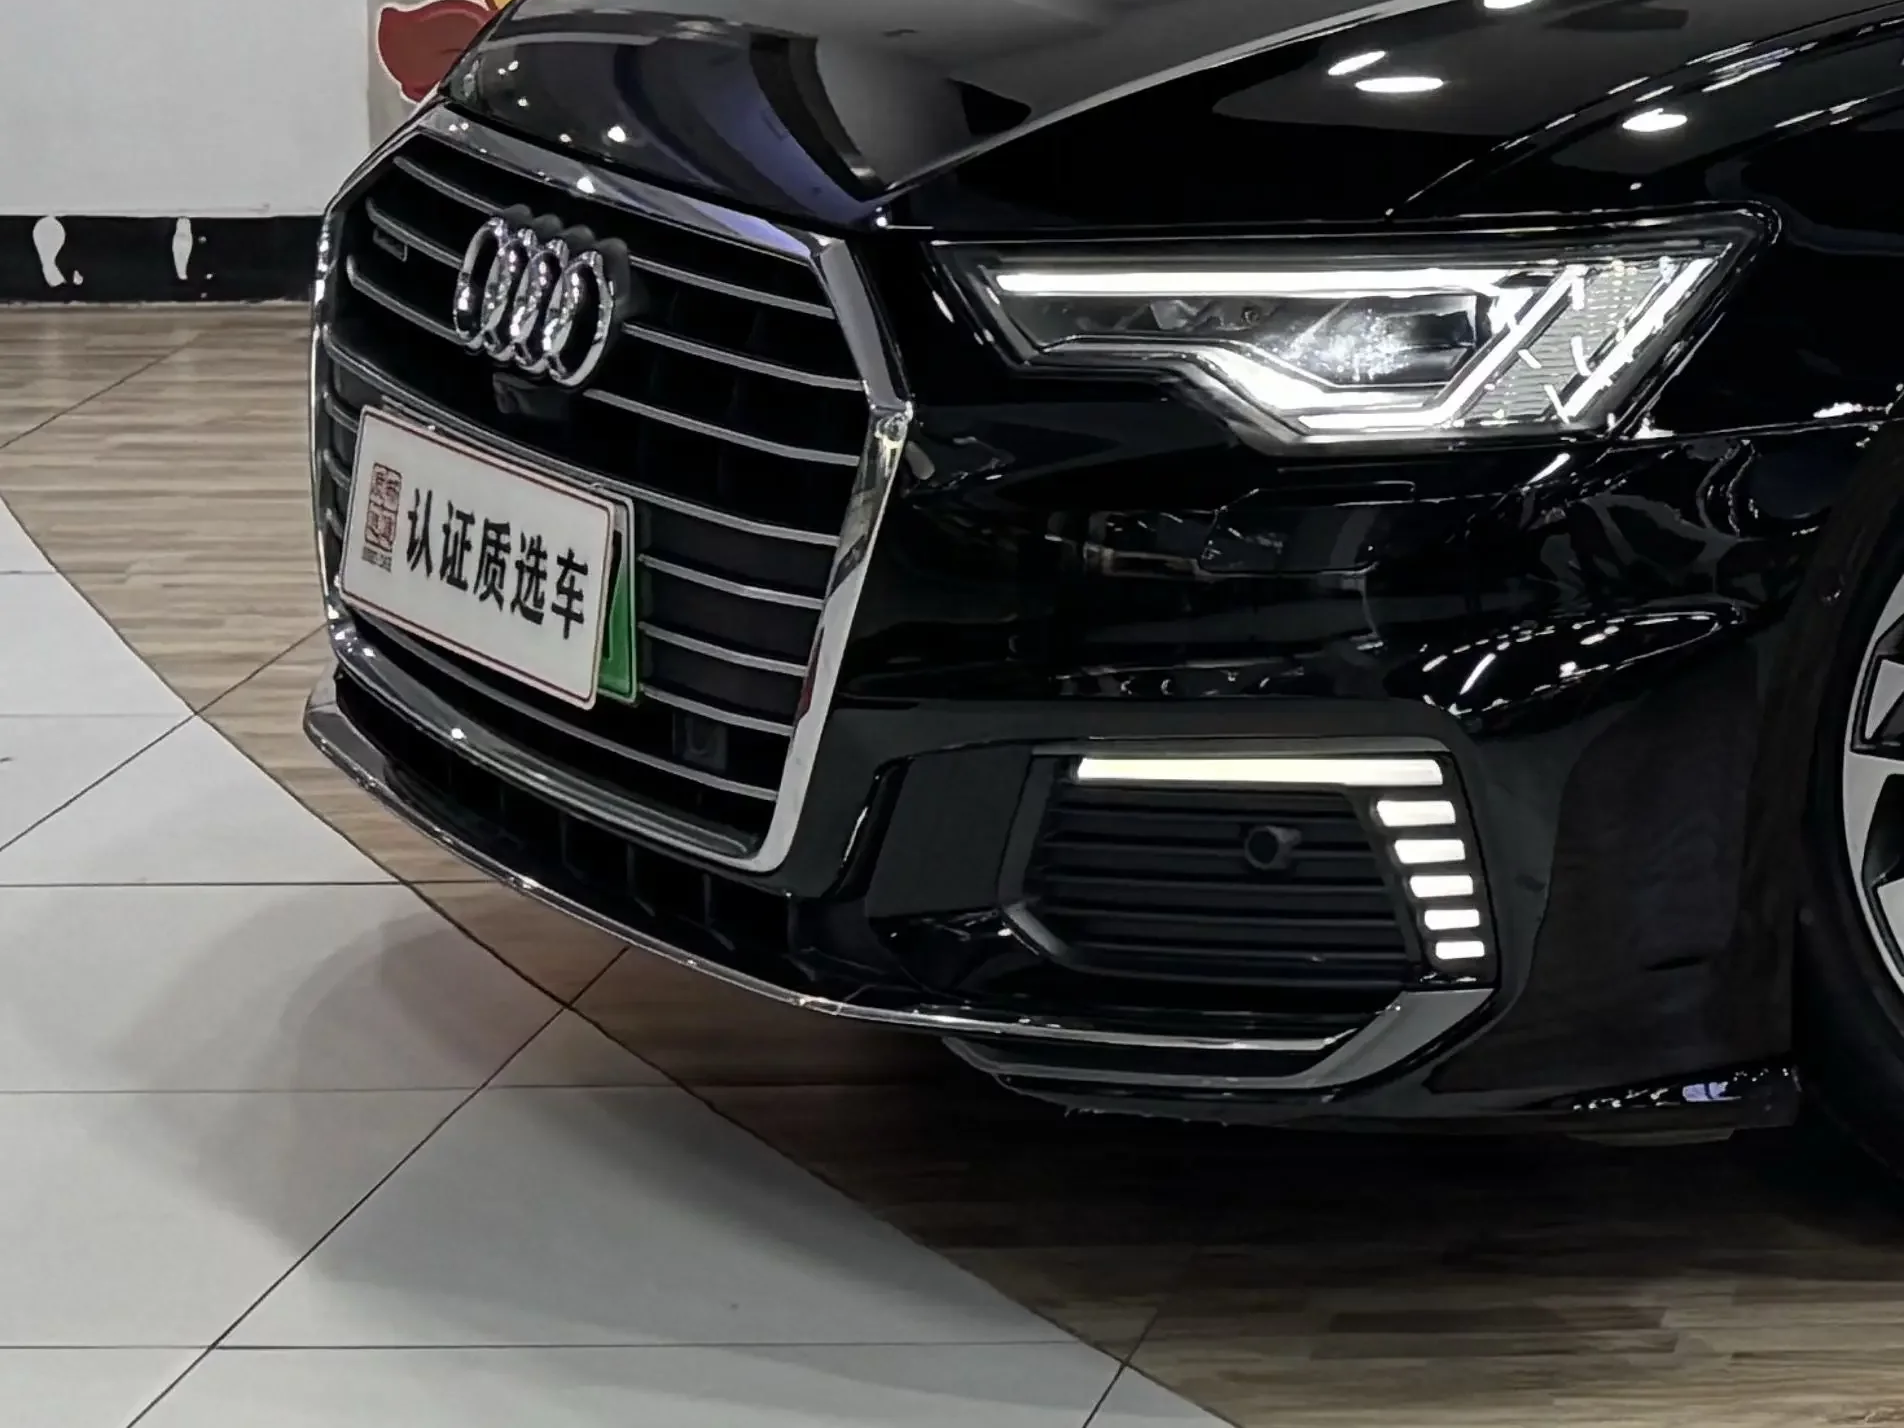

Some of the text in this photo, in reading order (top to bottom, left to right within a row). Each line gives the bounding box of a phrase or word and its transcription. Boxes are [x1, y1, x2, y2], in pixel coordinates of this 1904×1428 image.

[405, 487, 590, 640] 认证质选车
